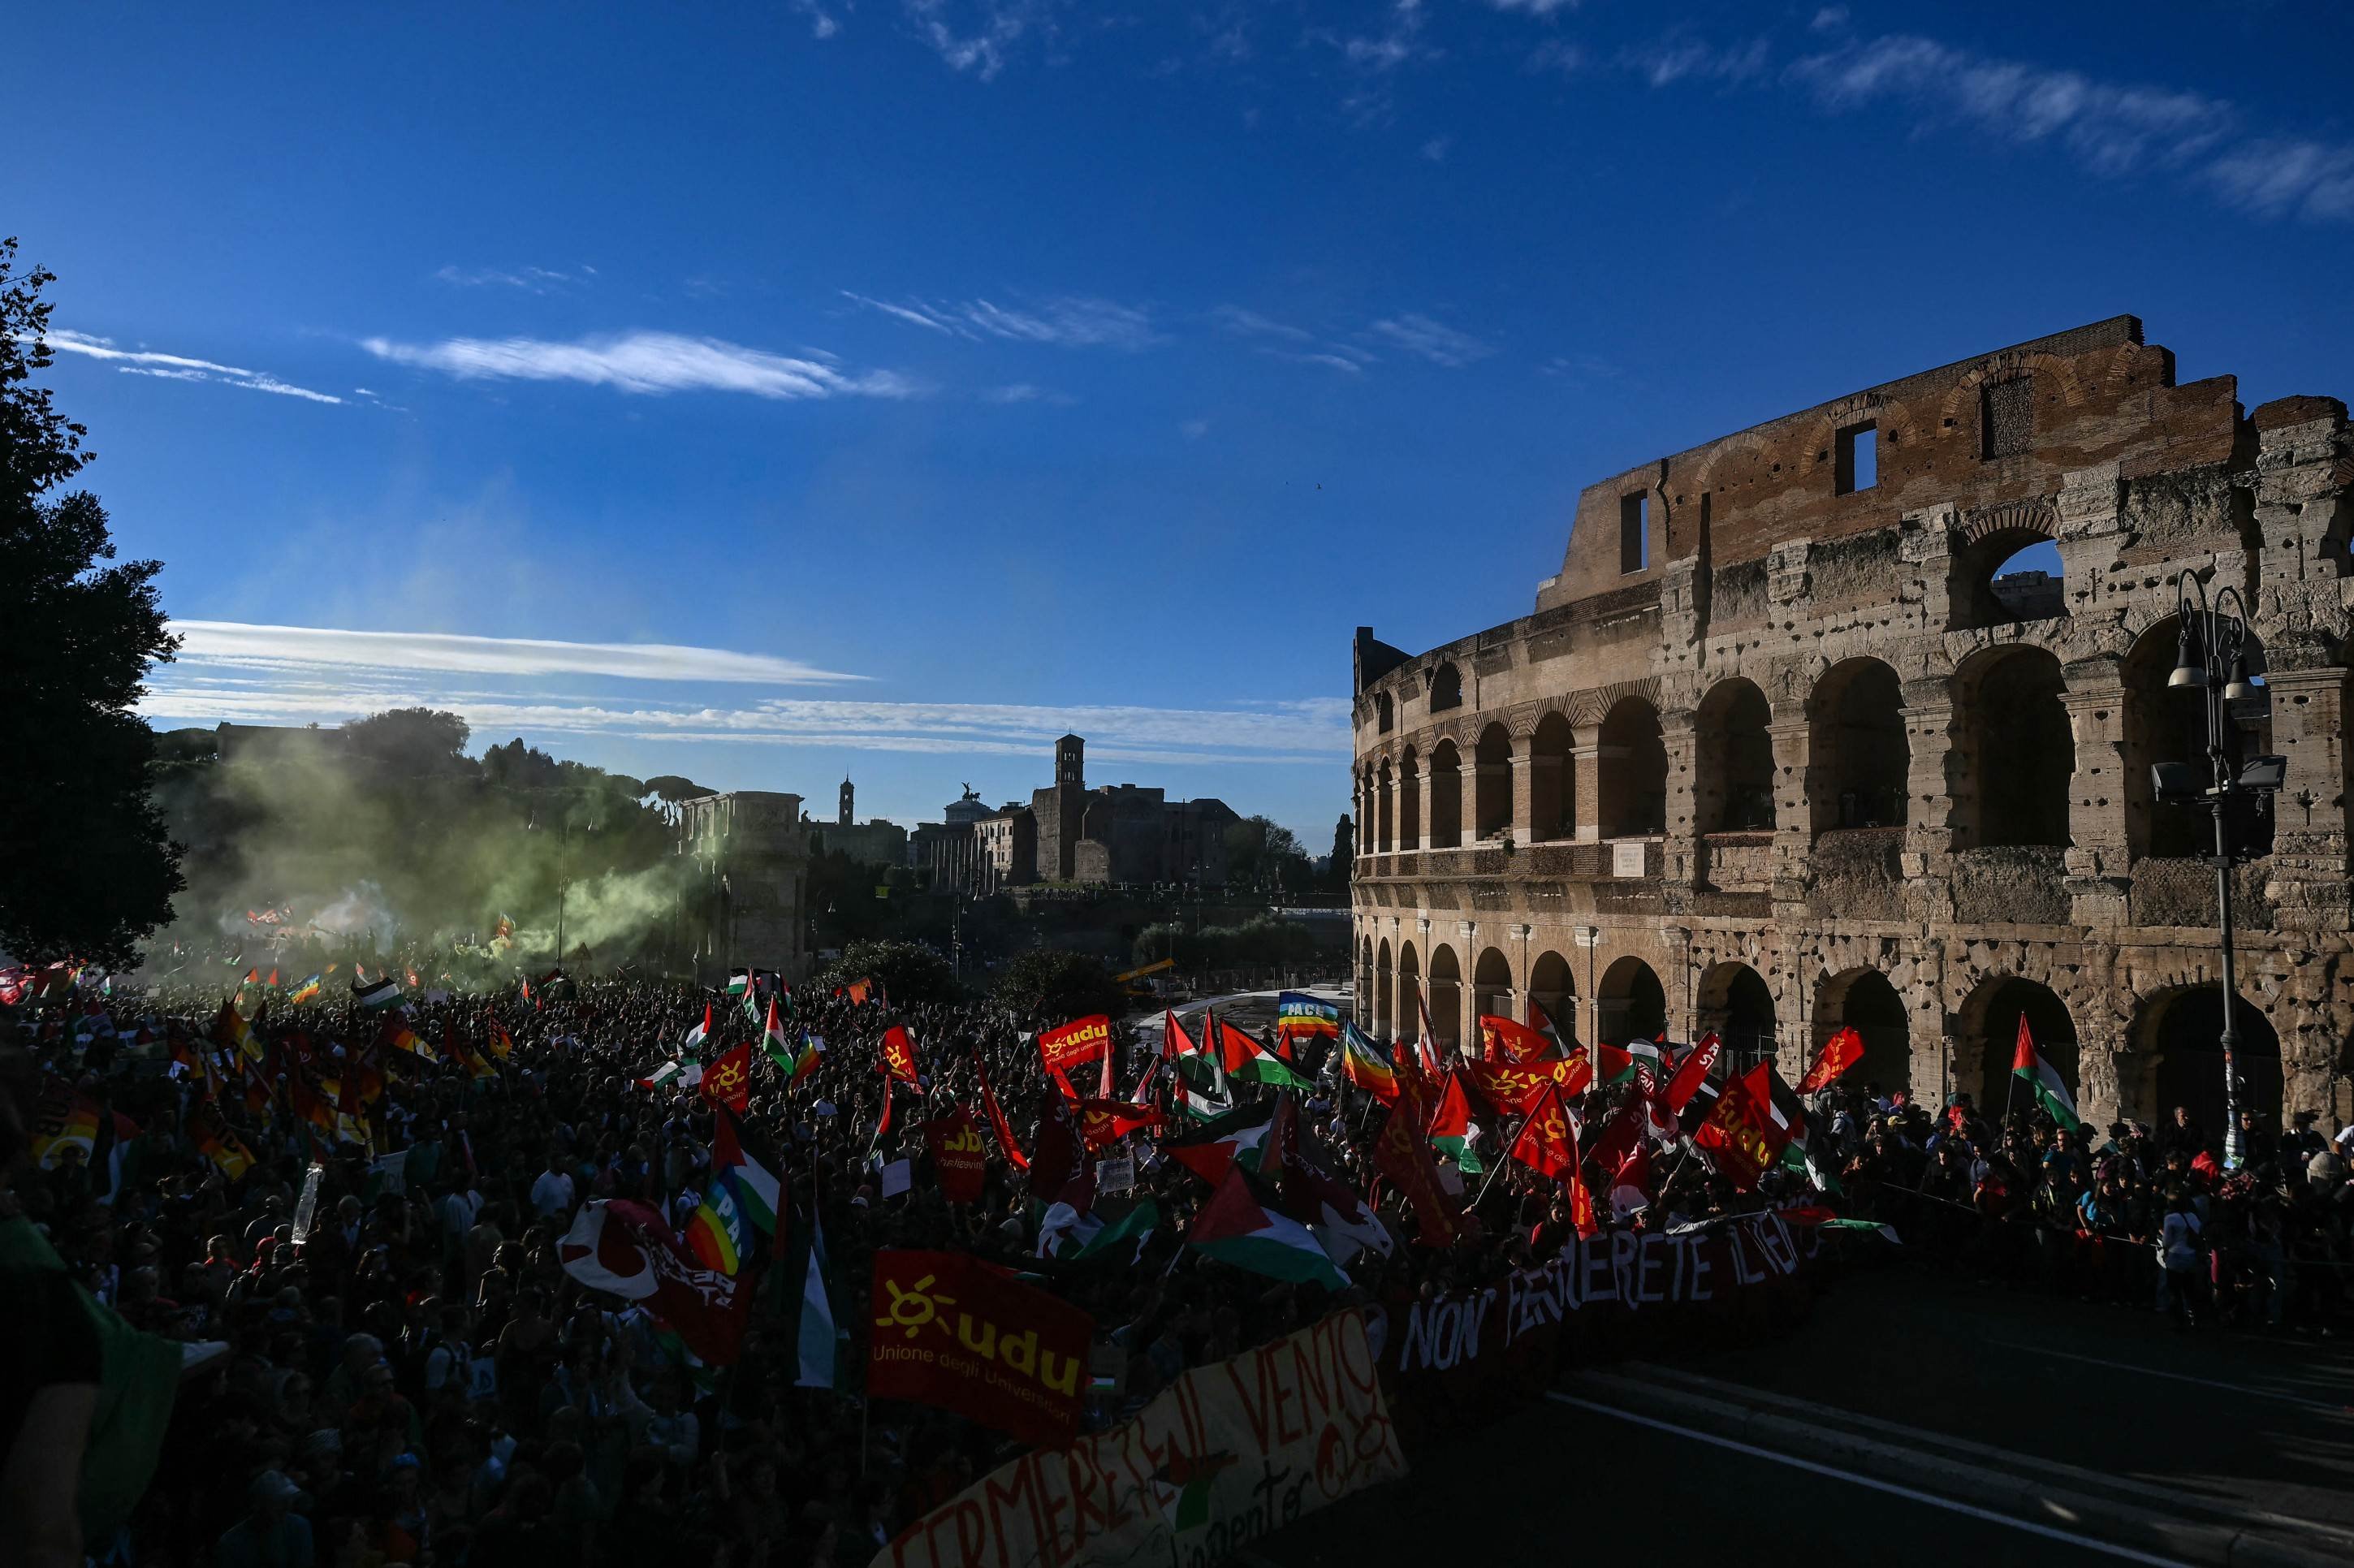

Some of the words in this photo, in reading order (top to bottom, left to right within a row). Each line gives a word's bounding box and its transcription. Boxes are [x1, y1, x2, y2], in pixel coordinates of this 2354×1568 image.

[1067, 1024, 1108, 1046] udu
[873, 1344, 935, 1363] Unione
[939, 1351, 981, 1379] degli
[958, 1311, 1081, 1397] udu
[1399, 1288, 1497, 1372] NON
[1225, 1308, 1376, 1456] VENTO
